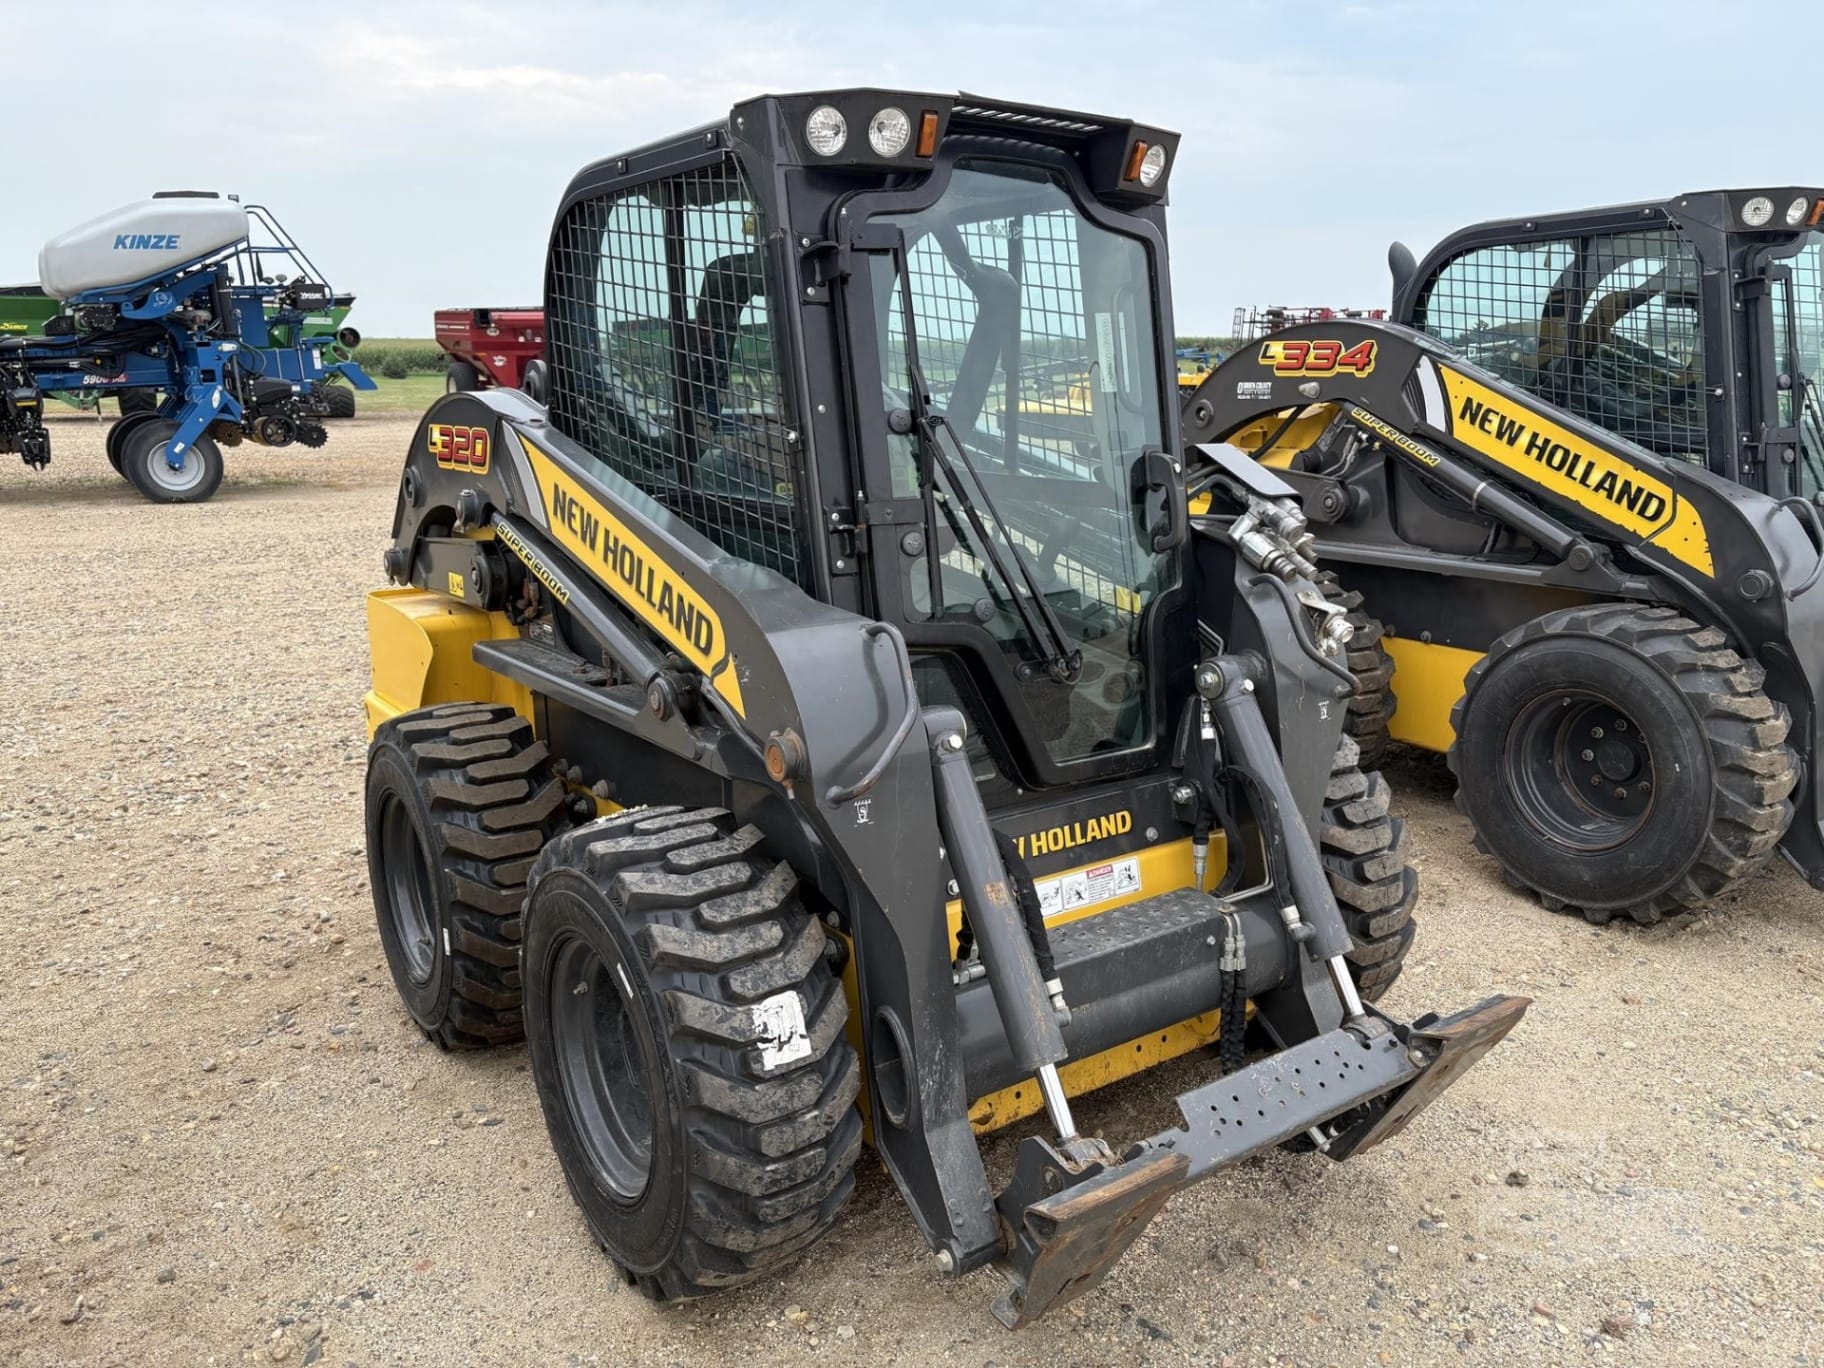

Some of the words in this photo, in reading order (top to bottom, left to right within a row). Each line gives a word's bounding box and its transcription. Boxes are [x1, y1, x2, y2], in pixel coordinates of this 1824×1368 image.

[113, 234, 181, 250] KINZE
[1259, 340, 1377, 377] L334
[428, 424, 490, 475] L320
[1352, 407, 1399, 441] SUPER
[1396, 434, 1440, 467] BOOM
[1459, 396, 1526, 447] NEW
[1524, 431, 1666, 522] HOLLAND
[497, 522, 535, 569] SUPER
[533, 560, 569, 605] BOOM
[553, 482, 599, 552] NEW
[603, 527, 713, 657] HOLLAND
[1030, 810, 1132, 857] HOLLAND
